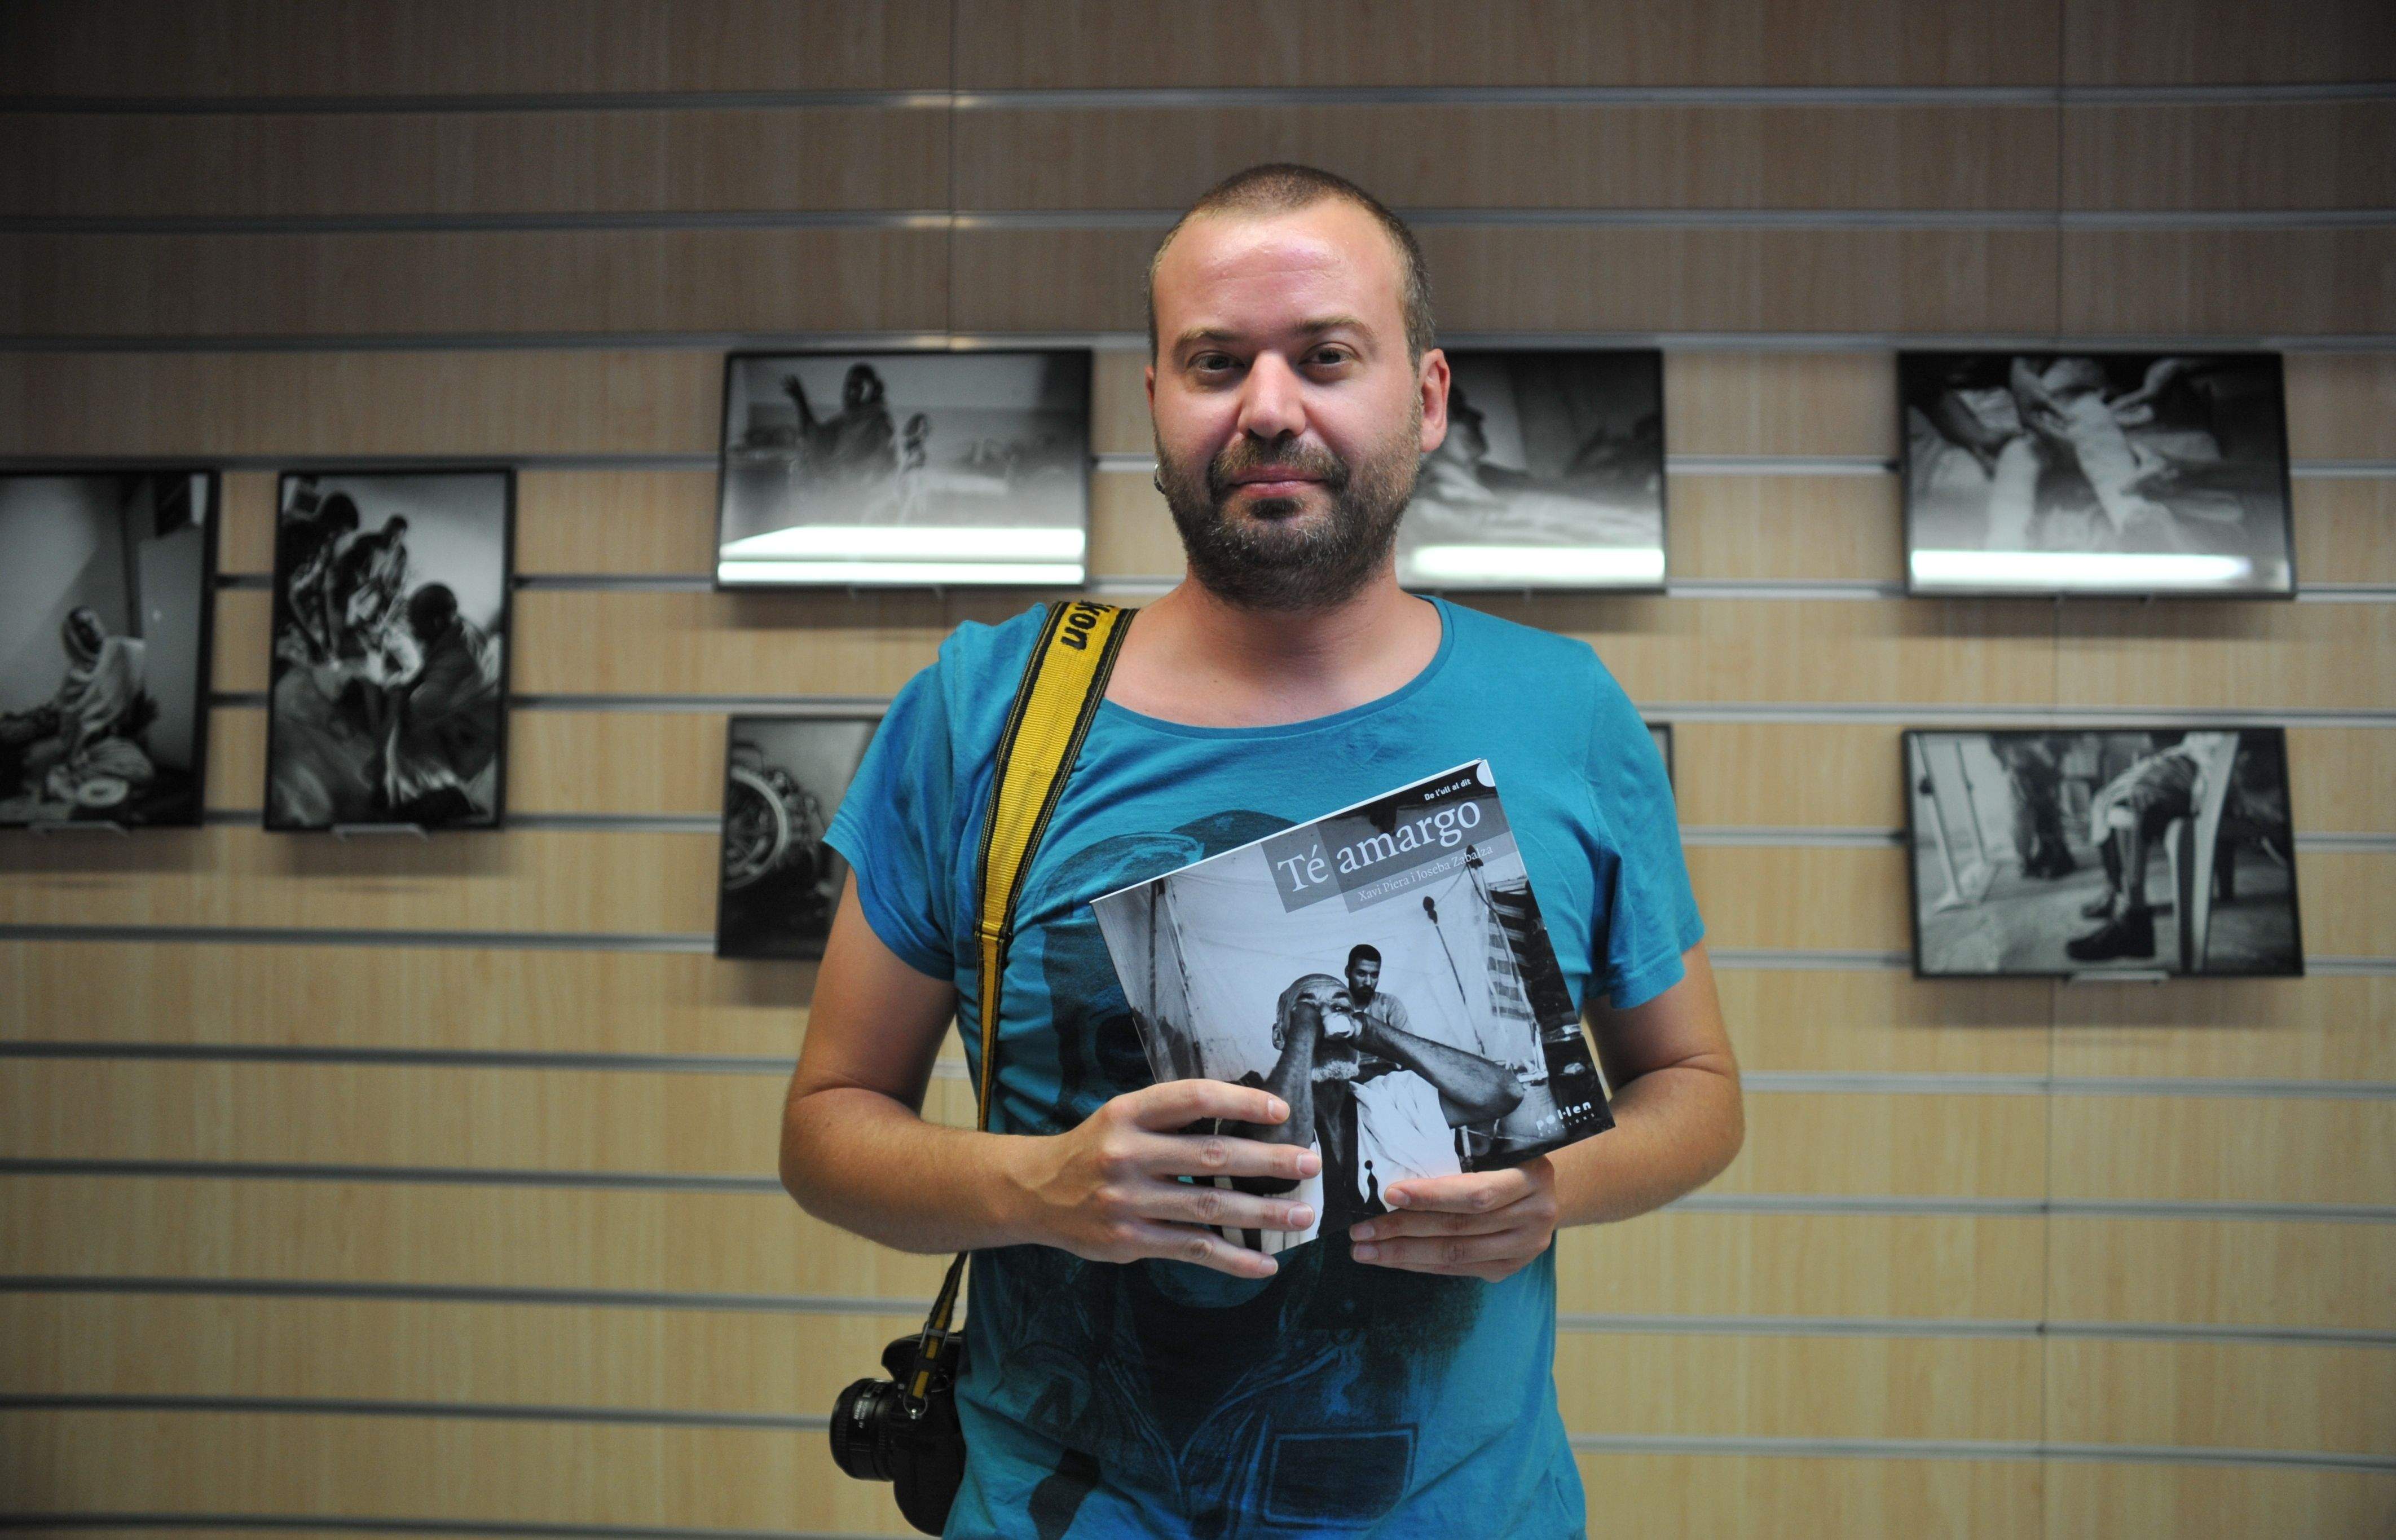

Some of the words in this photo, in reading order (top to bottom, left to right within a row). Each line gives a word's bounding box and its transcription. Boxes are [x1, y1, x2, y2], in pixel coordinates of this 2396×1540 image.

[1452, 782, 1460, 791] al
[1460, 778, 1472, 787] dit
[1278, 844, 1329, 893] Té
[1336, 801, 1481, 874] amargo
[1358, 885, 1382, 902] Xavi
[1382, 877, 1410, 892] Piera
[1411, 872, 1416, 882] i
[1416, 861, 1450, 881] Joseba
[1451, 846, 1494, 868] Zabalza
